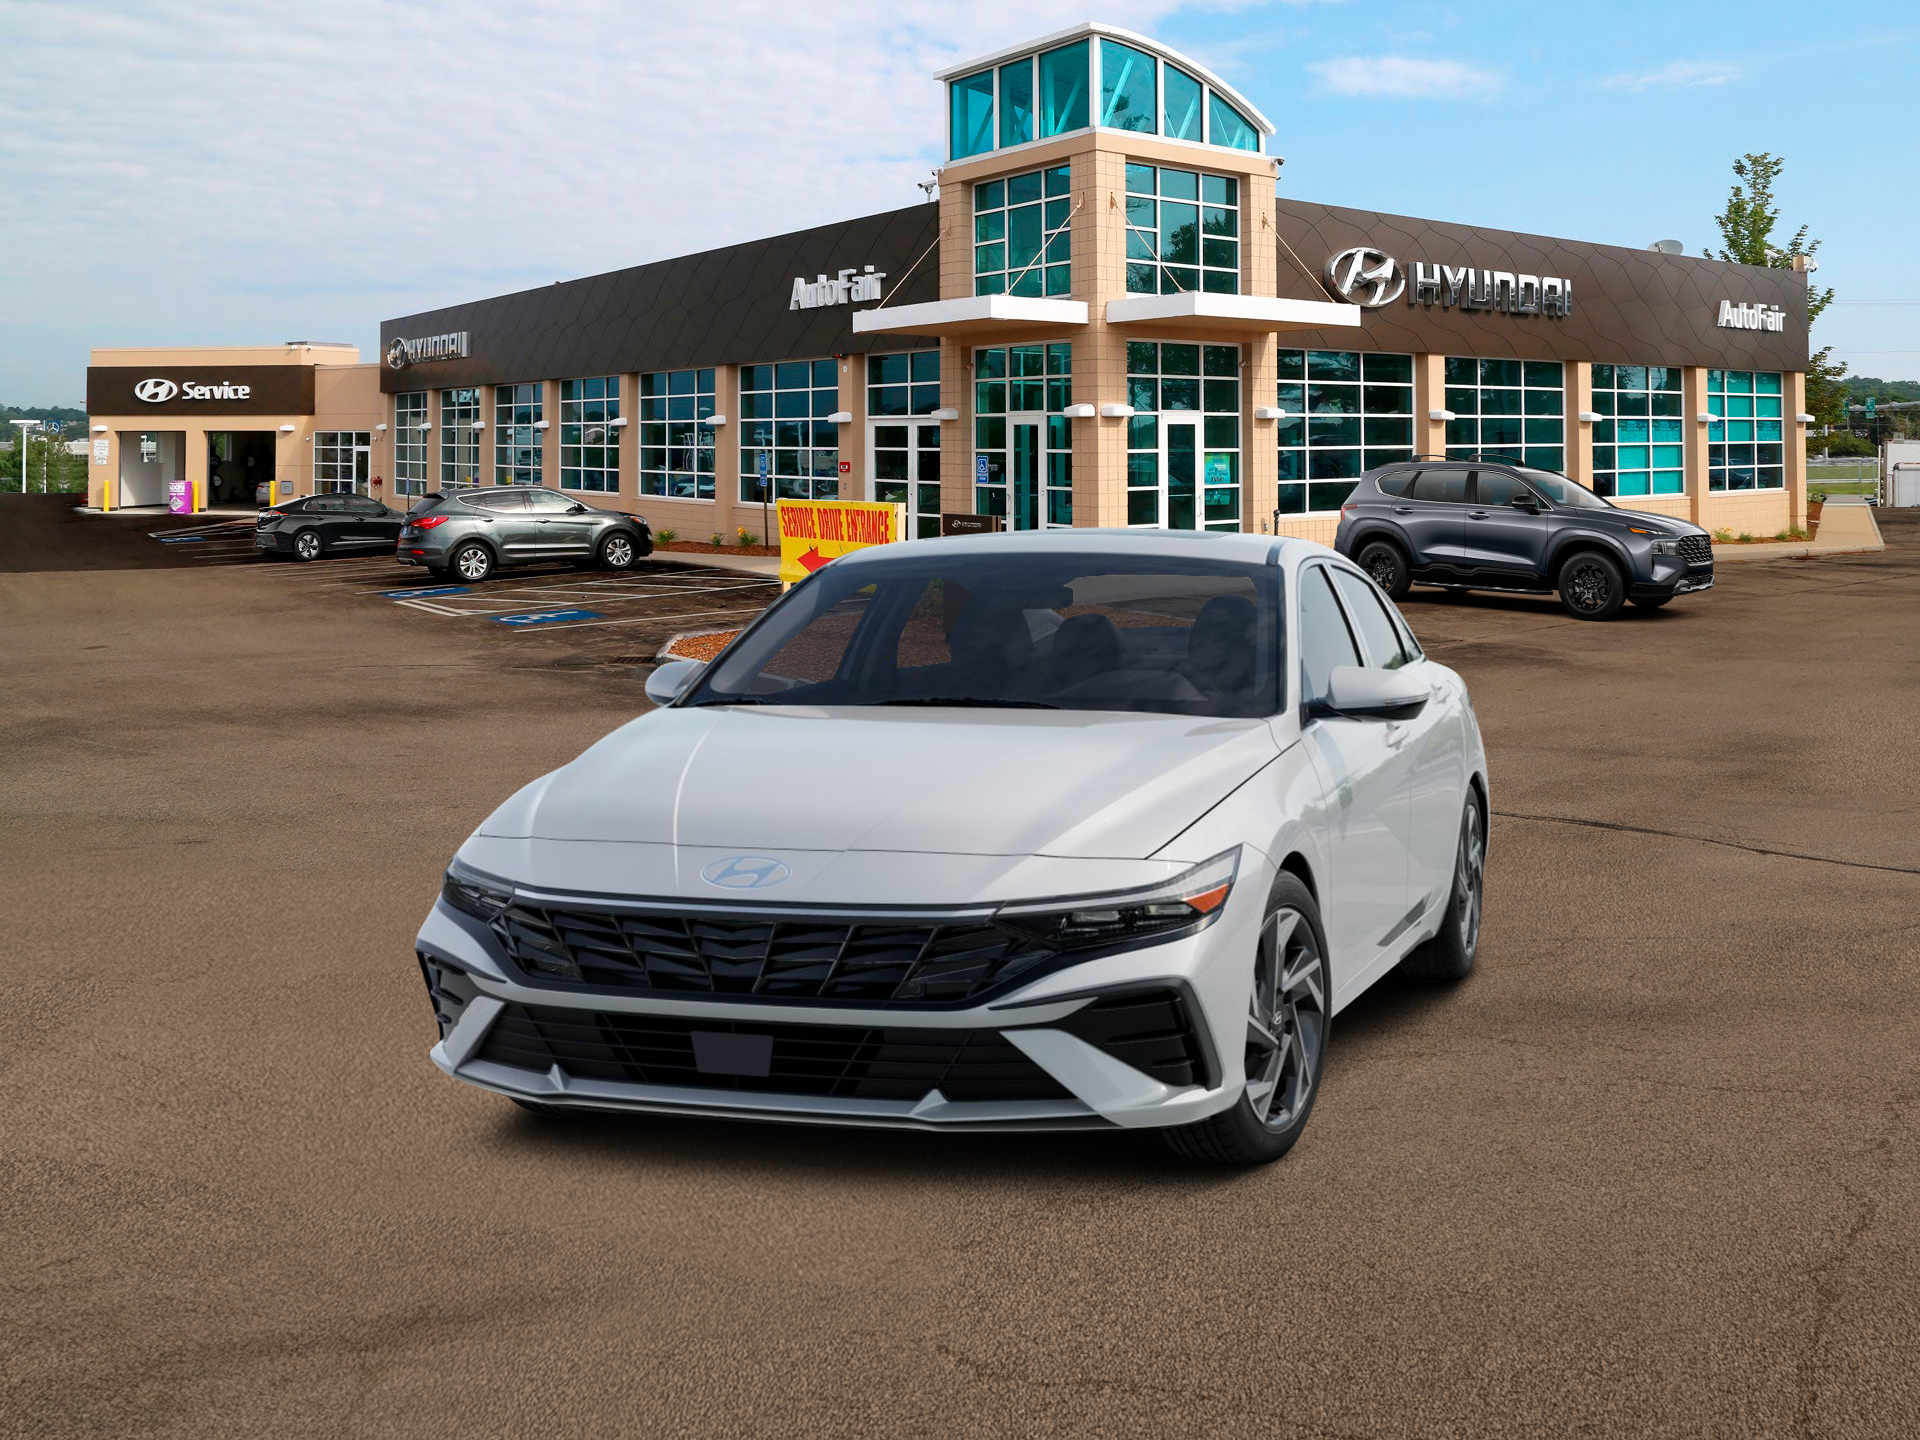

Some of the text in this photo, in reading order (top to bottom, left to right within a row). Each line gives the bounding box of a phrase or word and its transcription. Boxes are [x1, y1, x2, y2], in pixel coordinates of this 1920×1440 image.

[789, 265, 887, 310] AutoFair
[1408, 261, 1572, 318] HYUNDAI
[1717, 299, 1786, 332] AutoFair
[407, 331, 470, 363] HYUNDAI
[182, 381, 250, 400] Service
[781, 506, 890, 545] SERVICE DRIVE ENTRANCE
